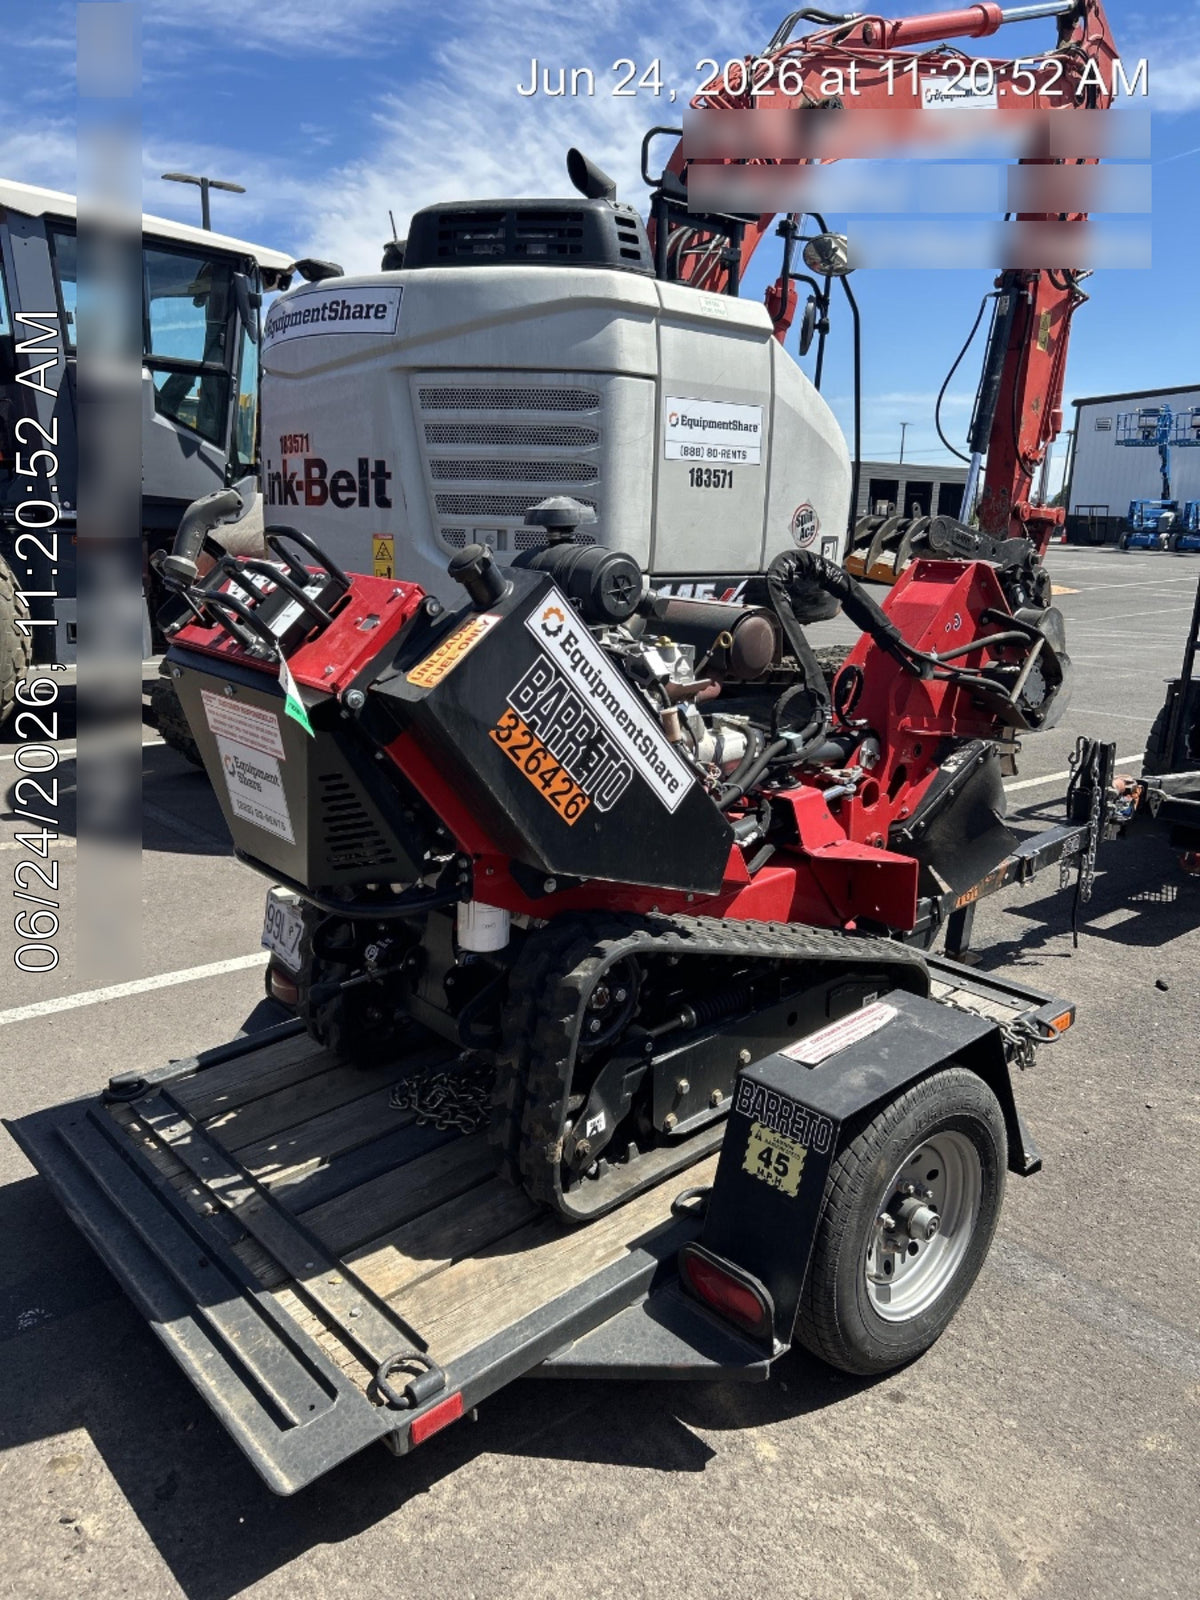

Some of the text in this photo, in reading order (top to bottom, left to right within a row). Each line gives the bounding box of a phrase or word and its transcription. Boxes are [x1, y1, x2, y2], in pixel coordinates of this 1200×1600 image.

[680, 415, 758, 433] EquipmentShare
[689, 467, 734, 489] 183571
[424, 619, 490, 685] FUEL ONLY
[506, 653, 634, 812] BARRETO
[559, 630, 682, 794] EquipmentShare
[233, 755, 281, 788] Equipment
[495, 713, 586, 820] 326426
[736, 1078, 833, 1154] BARRETO
[757, 1146, 790, 1177] 45
